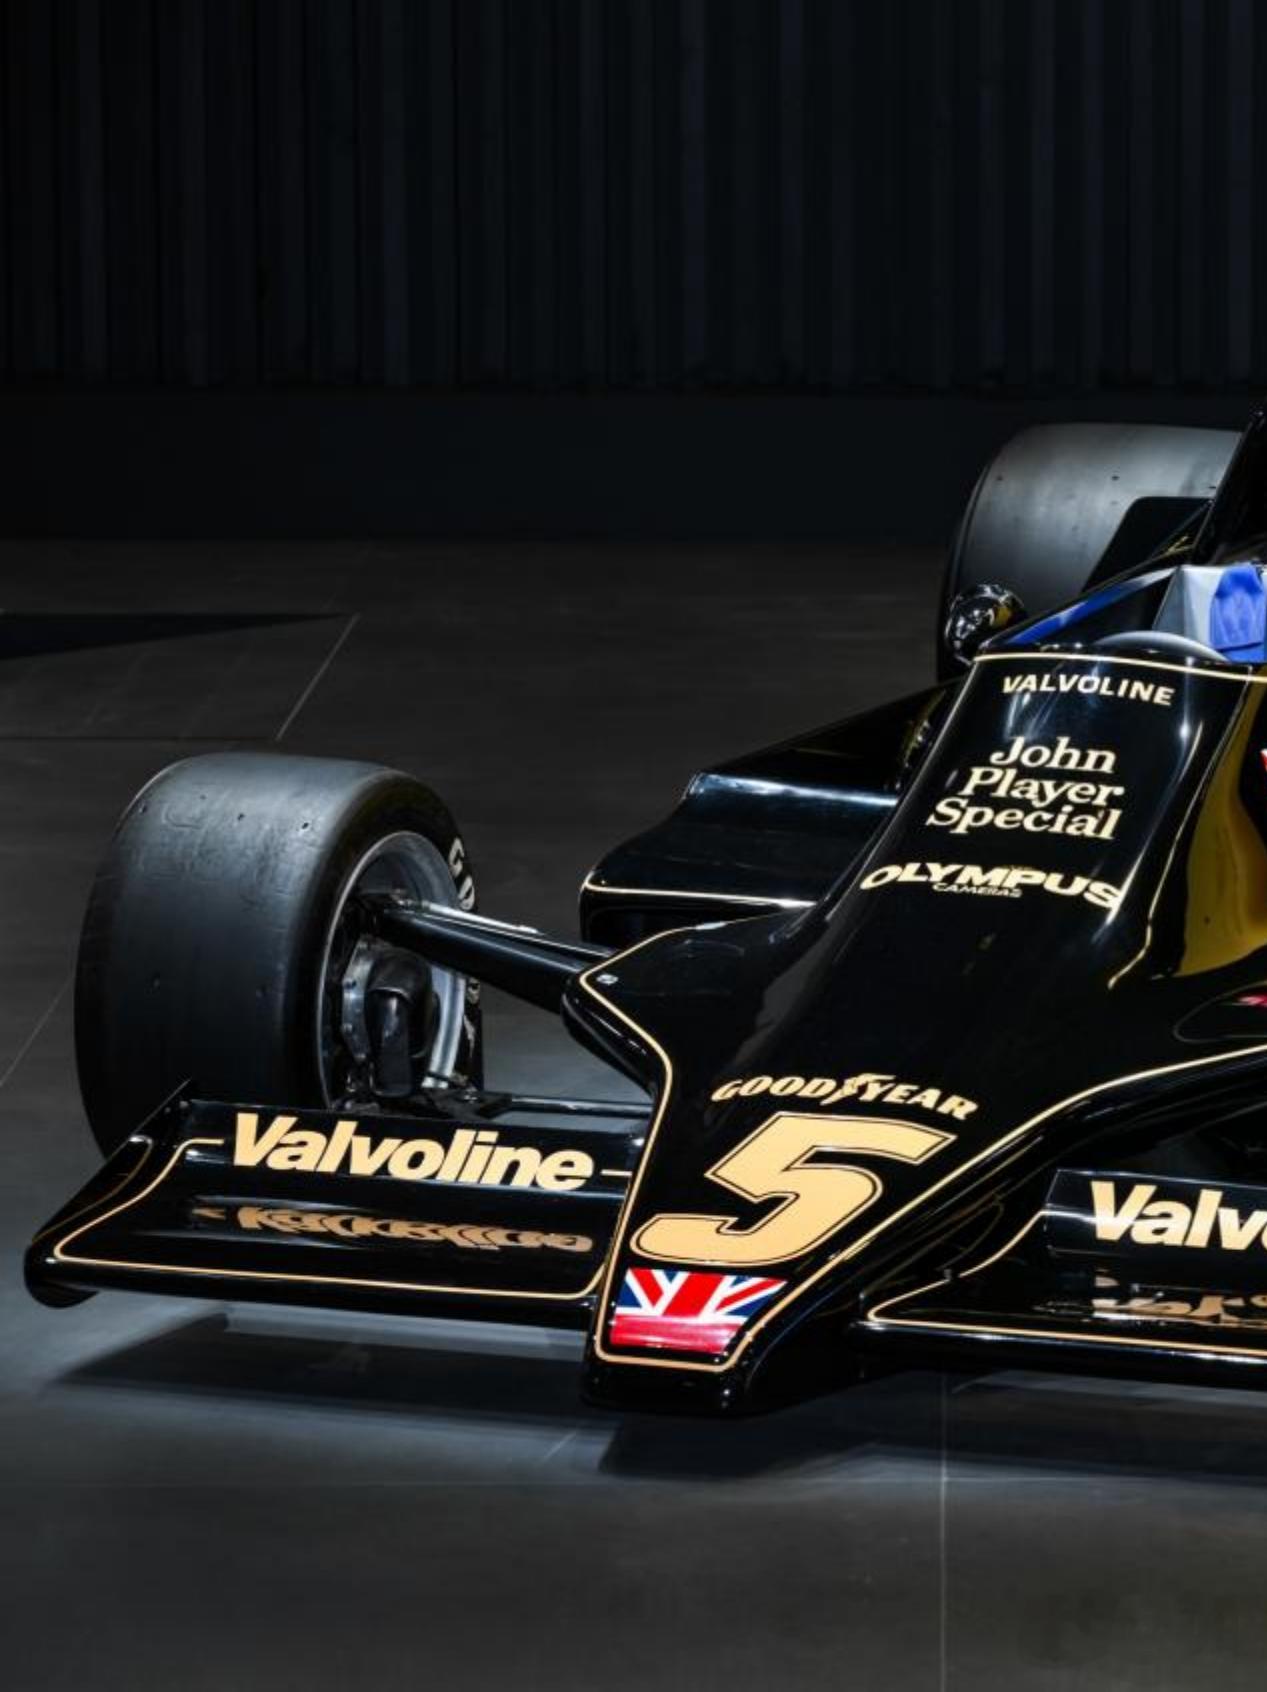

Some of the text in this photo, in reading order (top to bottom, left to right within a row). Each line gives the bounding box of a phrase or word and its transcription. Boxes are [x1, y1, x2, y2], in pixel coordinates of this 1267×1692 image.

[1003, 673, 1175, 706] VALVOLINE
[989, 736, 1117, 774] John
[957, 766, 1125, 808] Player
[925, 797, 1122, 840] Special
[860, 862, 1127, 909] OLYMPUS
[710, 1072, 978, 1121] GOODYEAR
[230, 1112, 595, 1192] Valvoline
[628, 1110, 959, 1268] 5
